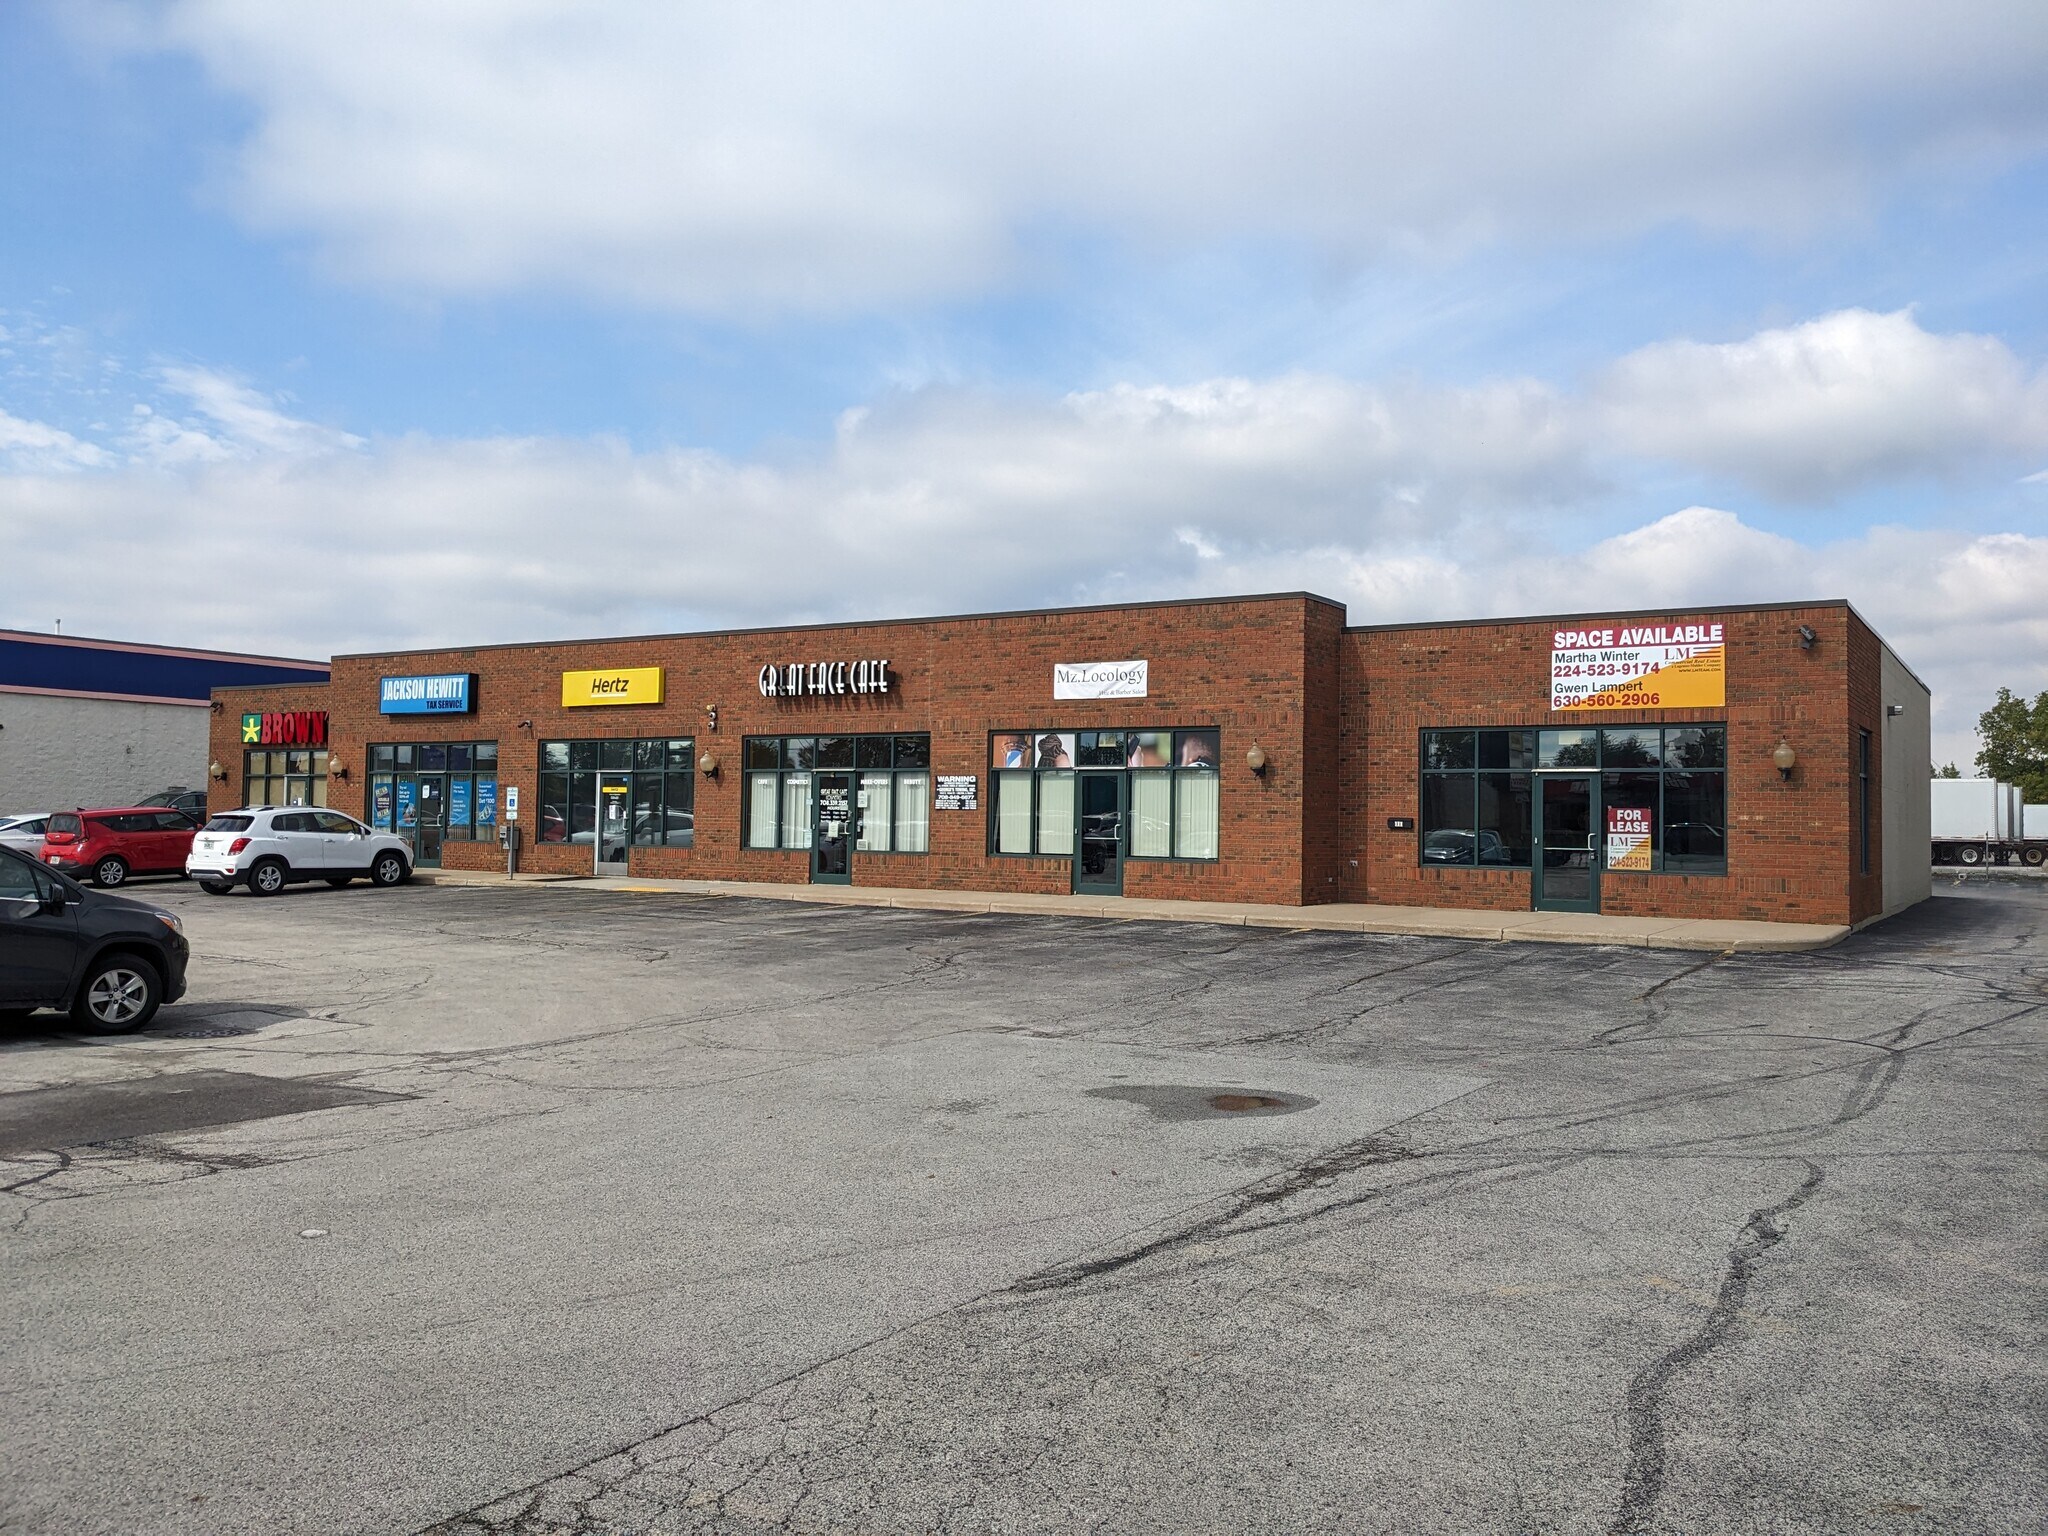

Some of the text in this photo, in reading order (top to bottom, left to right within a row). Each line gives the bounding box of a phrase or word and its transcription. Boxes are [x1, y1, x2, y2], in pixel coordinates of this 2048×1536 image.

[1554, 625, 1723, 649] SPACE AVAILABLE
[1555, 651, 1640, 664] Martha Winter
[1664, 647, 1691, 660] LM
[1057, 668, 1146, 685] Mz.Locology
[1554, 662, 1660, 678] 224-523-9174
[592, 677, 630, 693] Hertz
[759, 660, 888, 697] GREAT FACE CAFE
[383, 678, 464, 700] JACKSON HEWITT
[1555, 681, 1643, 694] Gwen Lampert
[427, 700, 463, 710] TAX SERVICE
[1554, 693, 1660, 707] 630-560-2906
[1617, 809, 1642, 821] FOR
[1609, 821, 1649, 833] LEASE
[1610, 836, 1629, 847] LM
[1609, 856, 1650, 868] 224-523-9174
